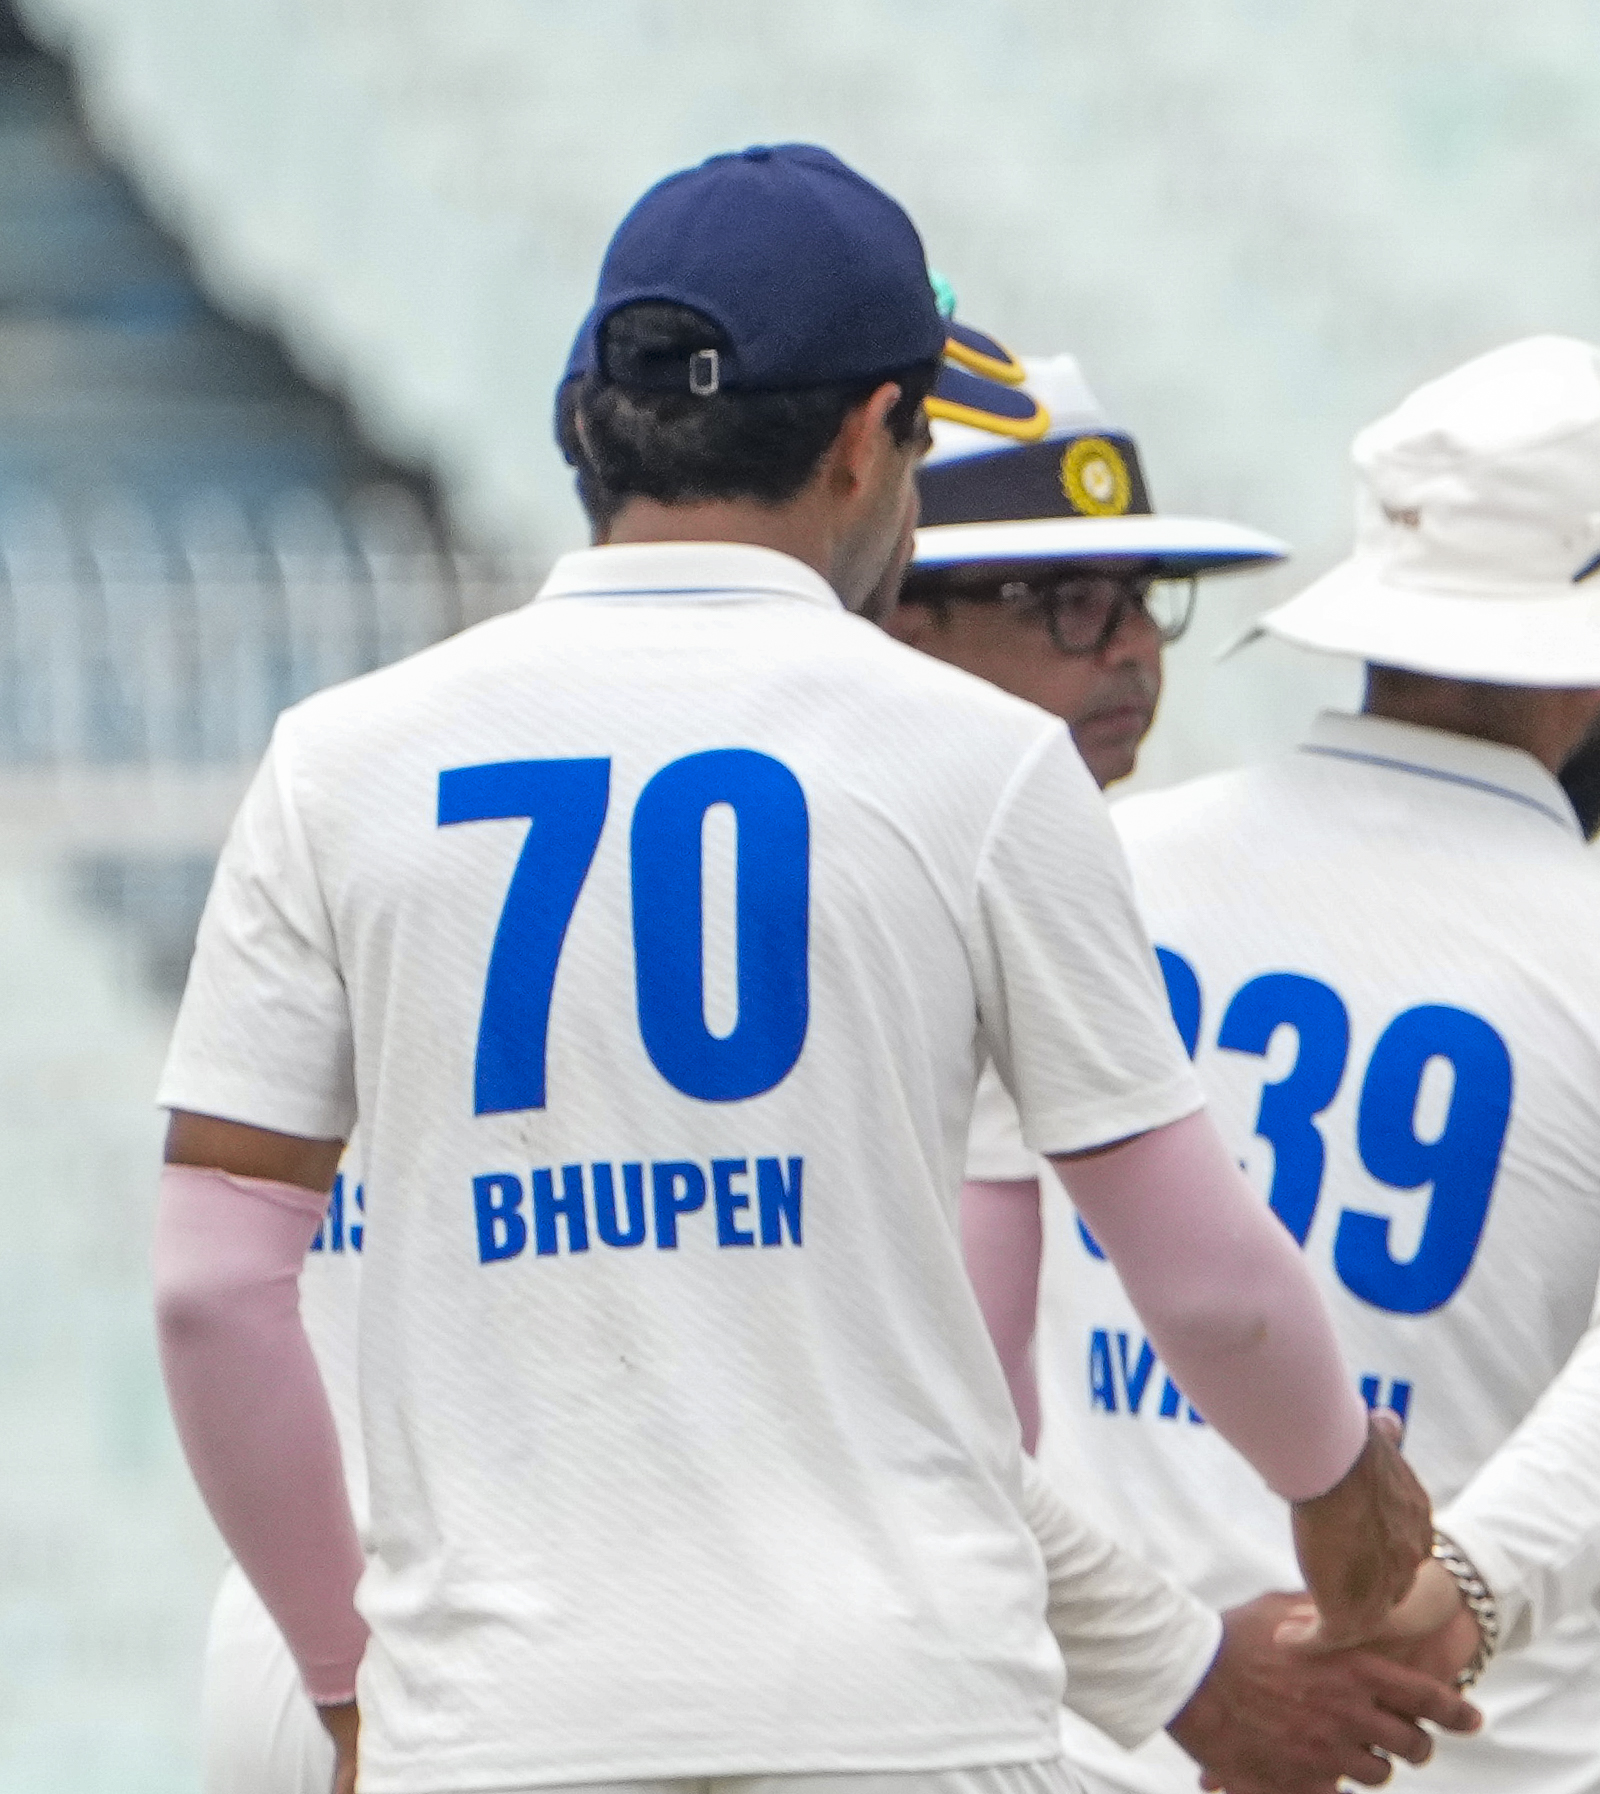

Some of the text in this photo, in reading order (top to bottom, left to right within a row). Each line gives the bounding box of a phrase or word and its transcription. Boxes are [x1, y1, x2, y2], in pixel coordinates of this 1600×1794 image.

[437, 747, 811, 1118] 70
[472, 1155, 804, 1266] BHUPEN
[1075, 944, 1515, 1317] 39
